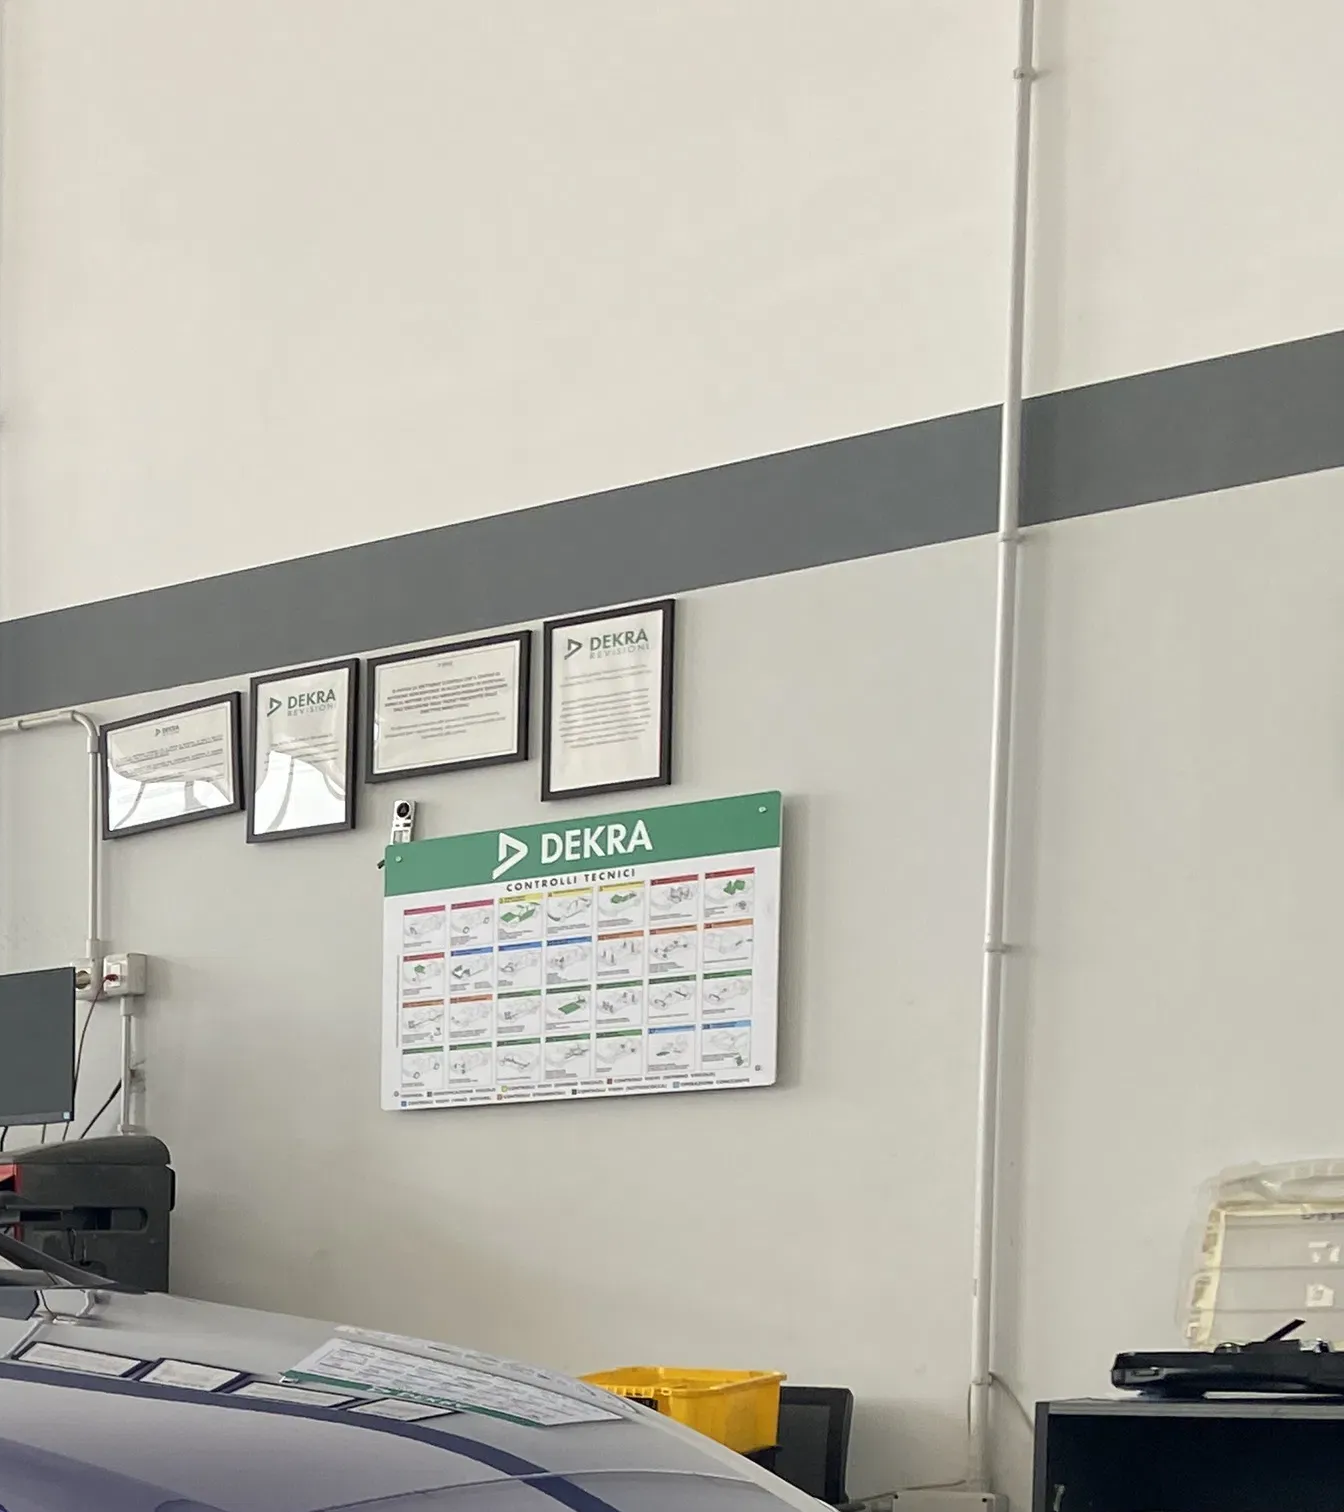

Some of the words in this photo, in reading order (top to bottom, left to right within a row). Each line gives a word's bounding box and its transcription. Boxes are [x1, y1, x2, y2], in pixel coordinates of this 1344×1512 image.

[590, 628, 648, 651] DEKRA
[589, 643, 650, 660] REVISIONI
[287, 688, 336, 709] DEKRA
[541, 819, 653, 864] DEKRA
[506, 875, 577, 893] CONTROLLI
[584, 868, 636, 883] TECNICI
